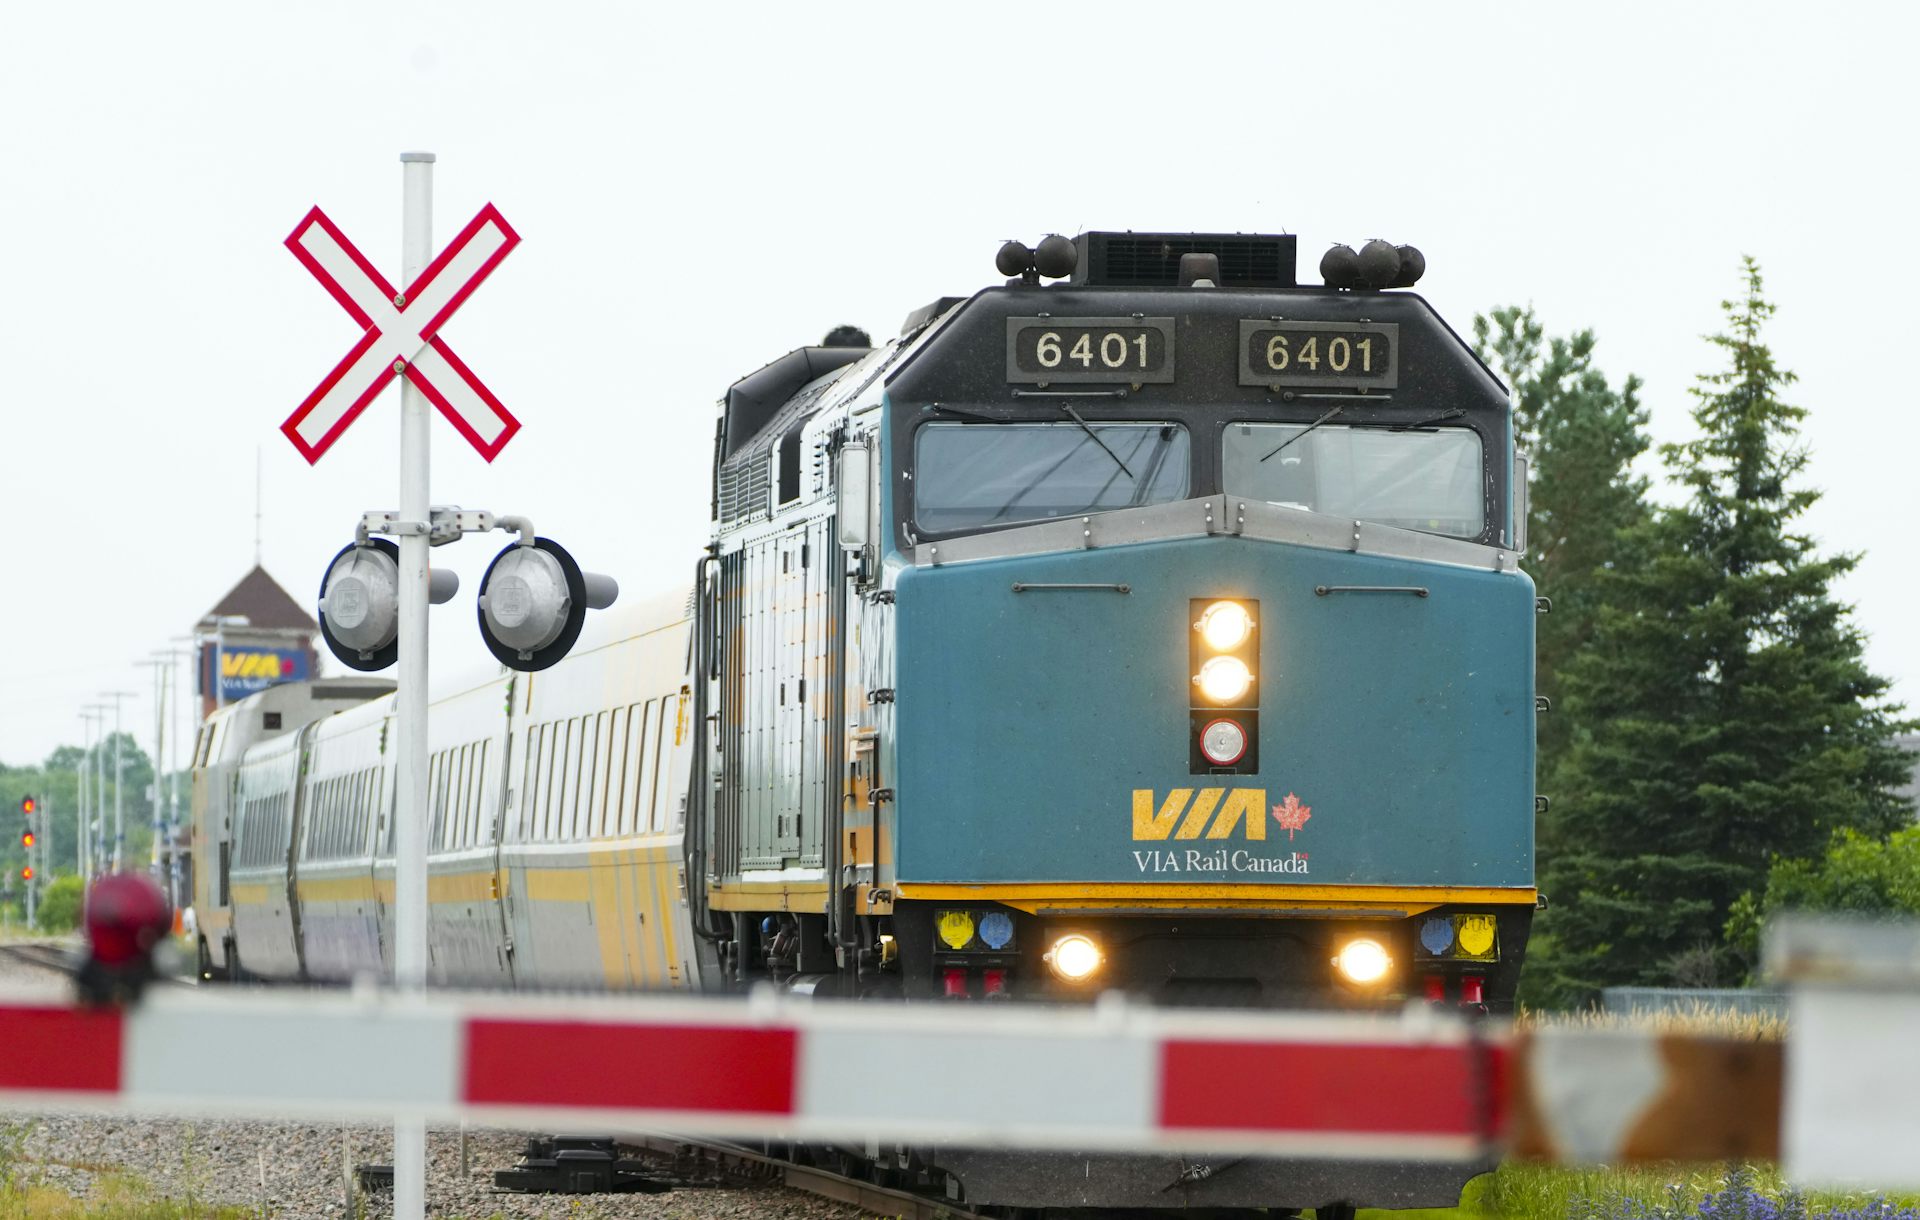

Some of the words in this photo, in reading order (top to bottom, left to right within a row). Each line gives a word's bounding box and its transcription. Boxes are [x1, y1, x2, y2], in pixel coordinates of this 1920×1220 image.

[1037, 332, 1147, 367] 6401
[1266, 335, 1371, 372] 6401
[222, 653, 279, 678] VIA
[1132, 788, 1266, 840] VIA
[1132, 850, 1181, 872] VIA
[1185, 850, 1228, 871] Rail
[1231, 850, 1309, 874] Canada
